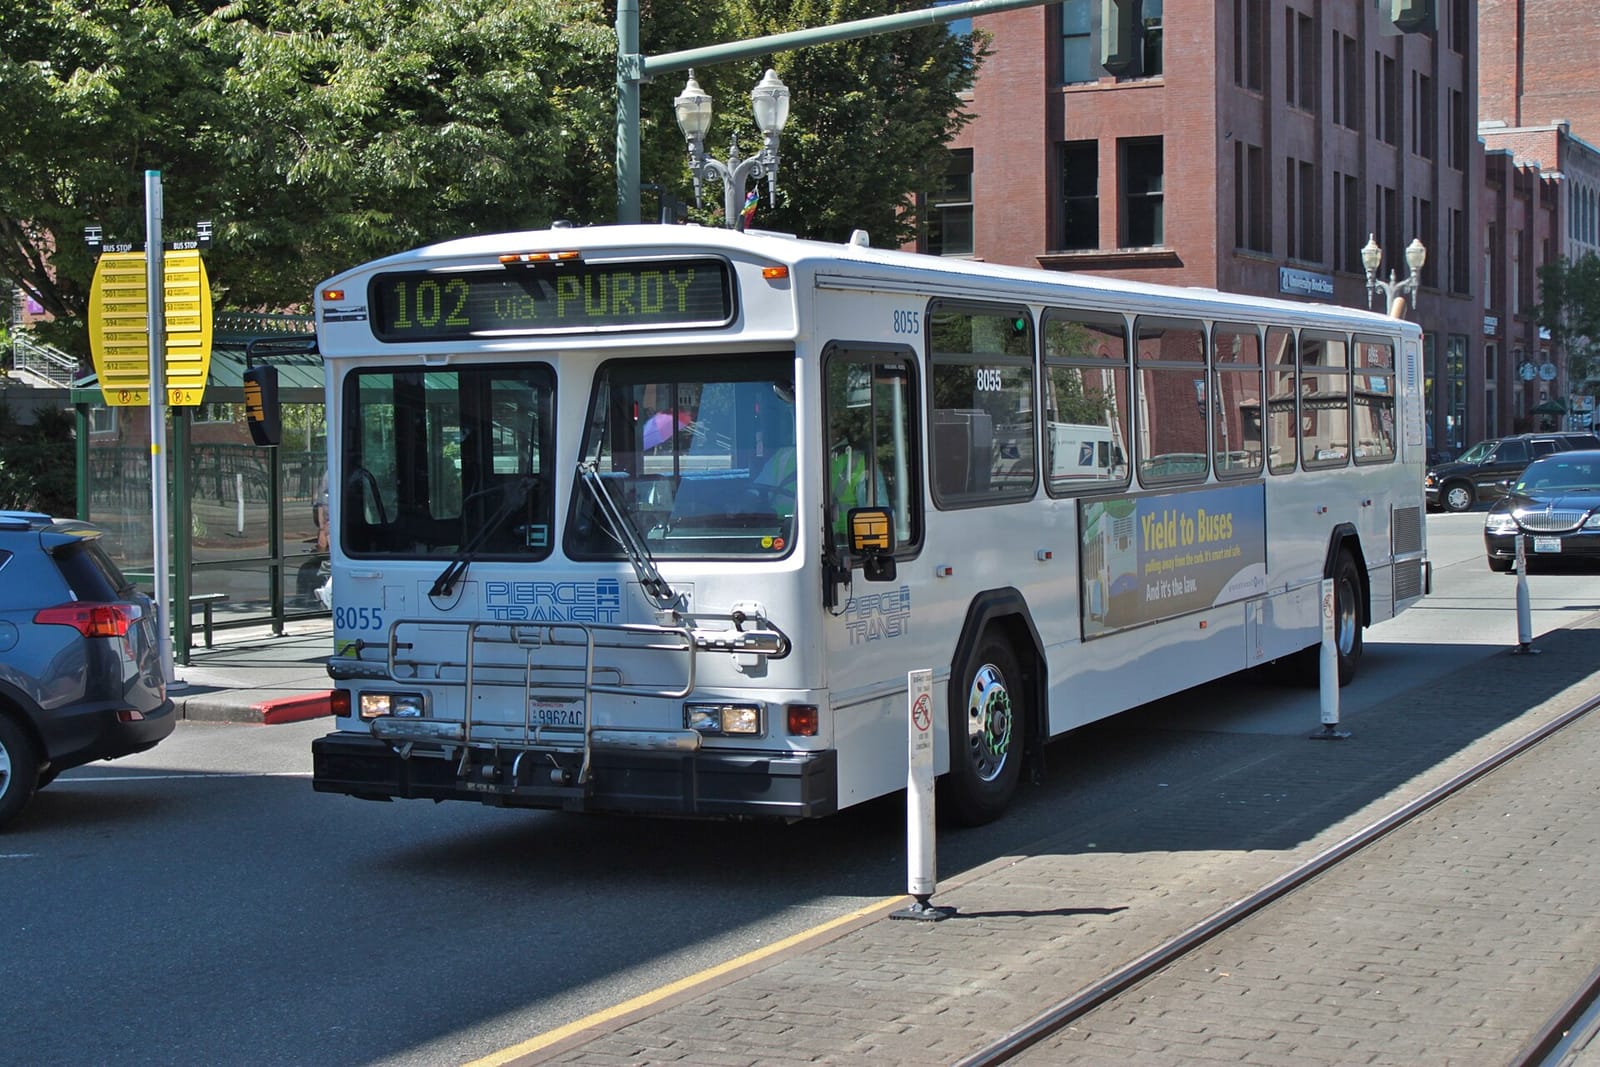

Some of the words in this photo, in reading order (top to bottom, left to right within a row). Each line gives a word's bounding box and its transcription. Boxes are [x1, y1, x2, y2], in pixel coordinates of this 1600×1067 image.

[102, 244, 115, 252] BUS
[116, 243, 132, 252] STOP
[173, 242, 184, 250] BUS
[185, 241, 198, 249] STOP
[1288, 273, 1312, 294] University
[393, 278, 470, 329] 102
[494, 295, 537, 320] via
[556, 268, 695, 318] PURDY
[893, 309, 920, 335] 8055
[977, 368, 1002, 392] 8055
[1141, 510, 1176, 551] Yield
[1180, 512, 1194, 547] to
[1198, 509, 1232, 543] Buses
[485, 581, 597, 605] PIERCE
[1146, 580, 1160, 602] And
[1160, 579, 1172, 600] it's
[1172, 576, 1184, 597] the
[1184, 575, 1198, 593] law.
[487, 605, 620, 625] TRANSIT
[845, 591, 901, 620] PIERCE
[335, 607, 383, 630] 8055
[846, 612, 910, 645] TRANSIT
